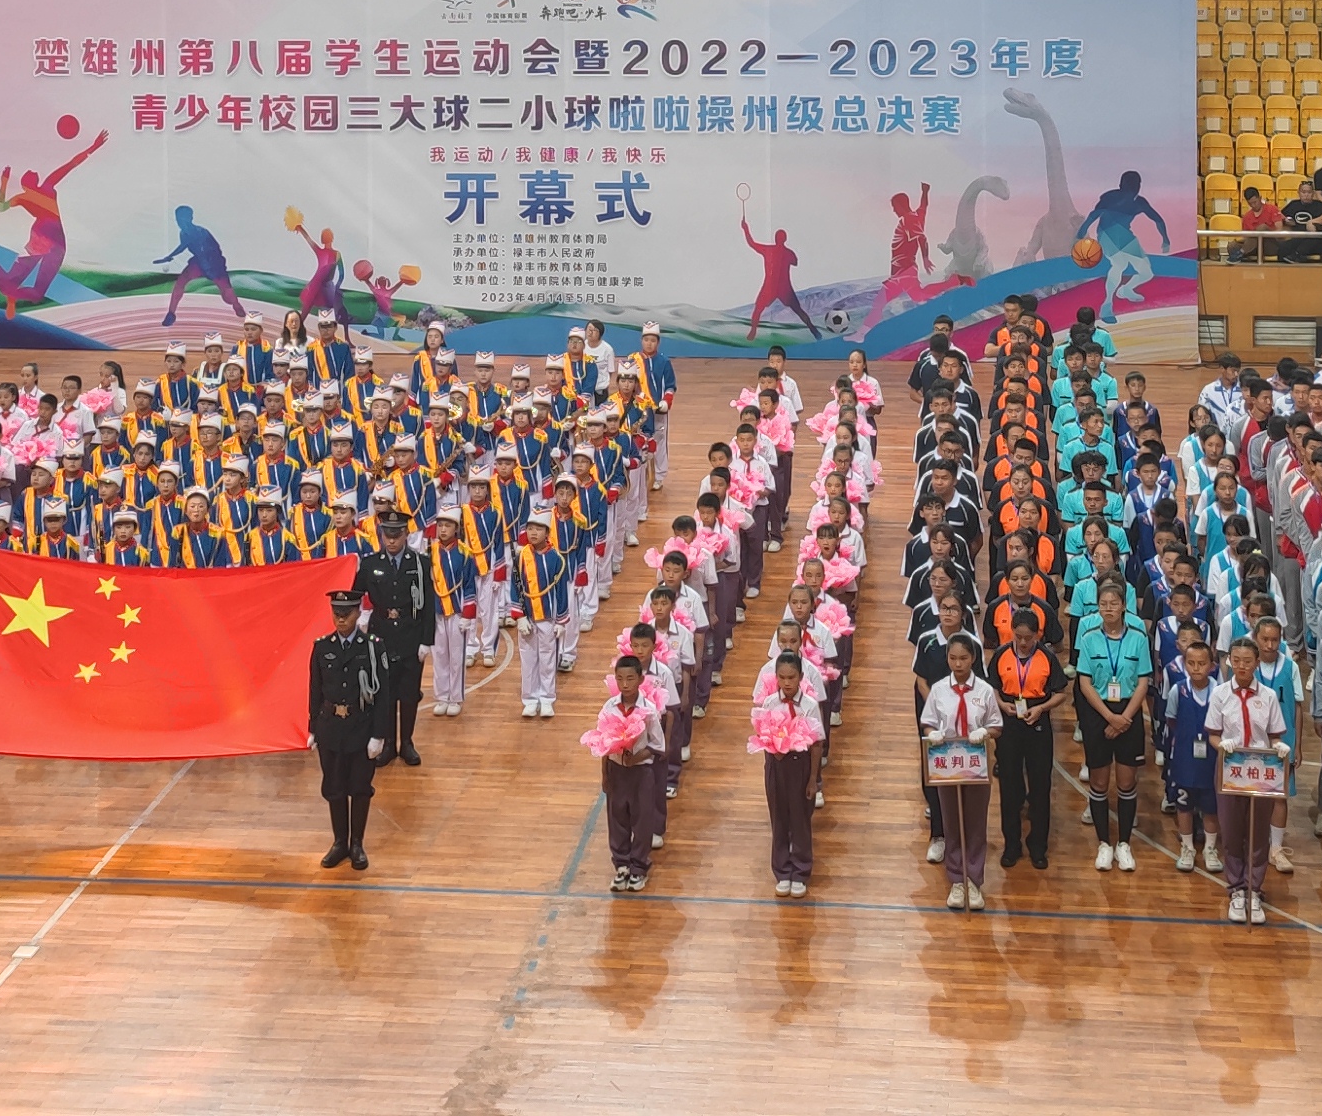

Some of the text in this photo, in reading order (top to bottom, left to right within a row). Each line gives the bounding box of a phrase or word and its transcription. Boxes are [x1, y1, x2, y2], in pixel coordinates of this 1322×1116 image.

[131, 93, 961, 134] 青少年校园三大球二小球啦啦操州级总决赛
[443, 169, 653, 228] 开幕式
[933, 755, 981, 770] 裁判员
[1230, 766, 1277, 781] 双柏县
